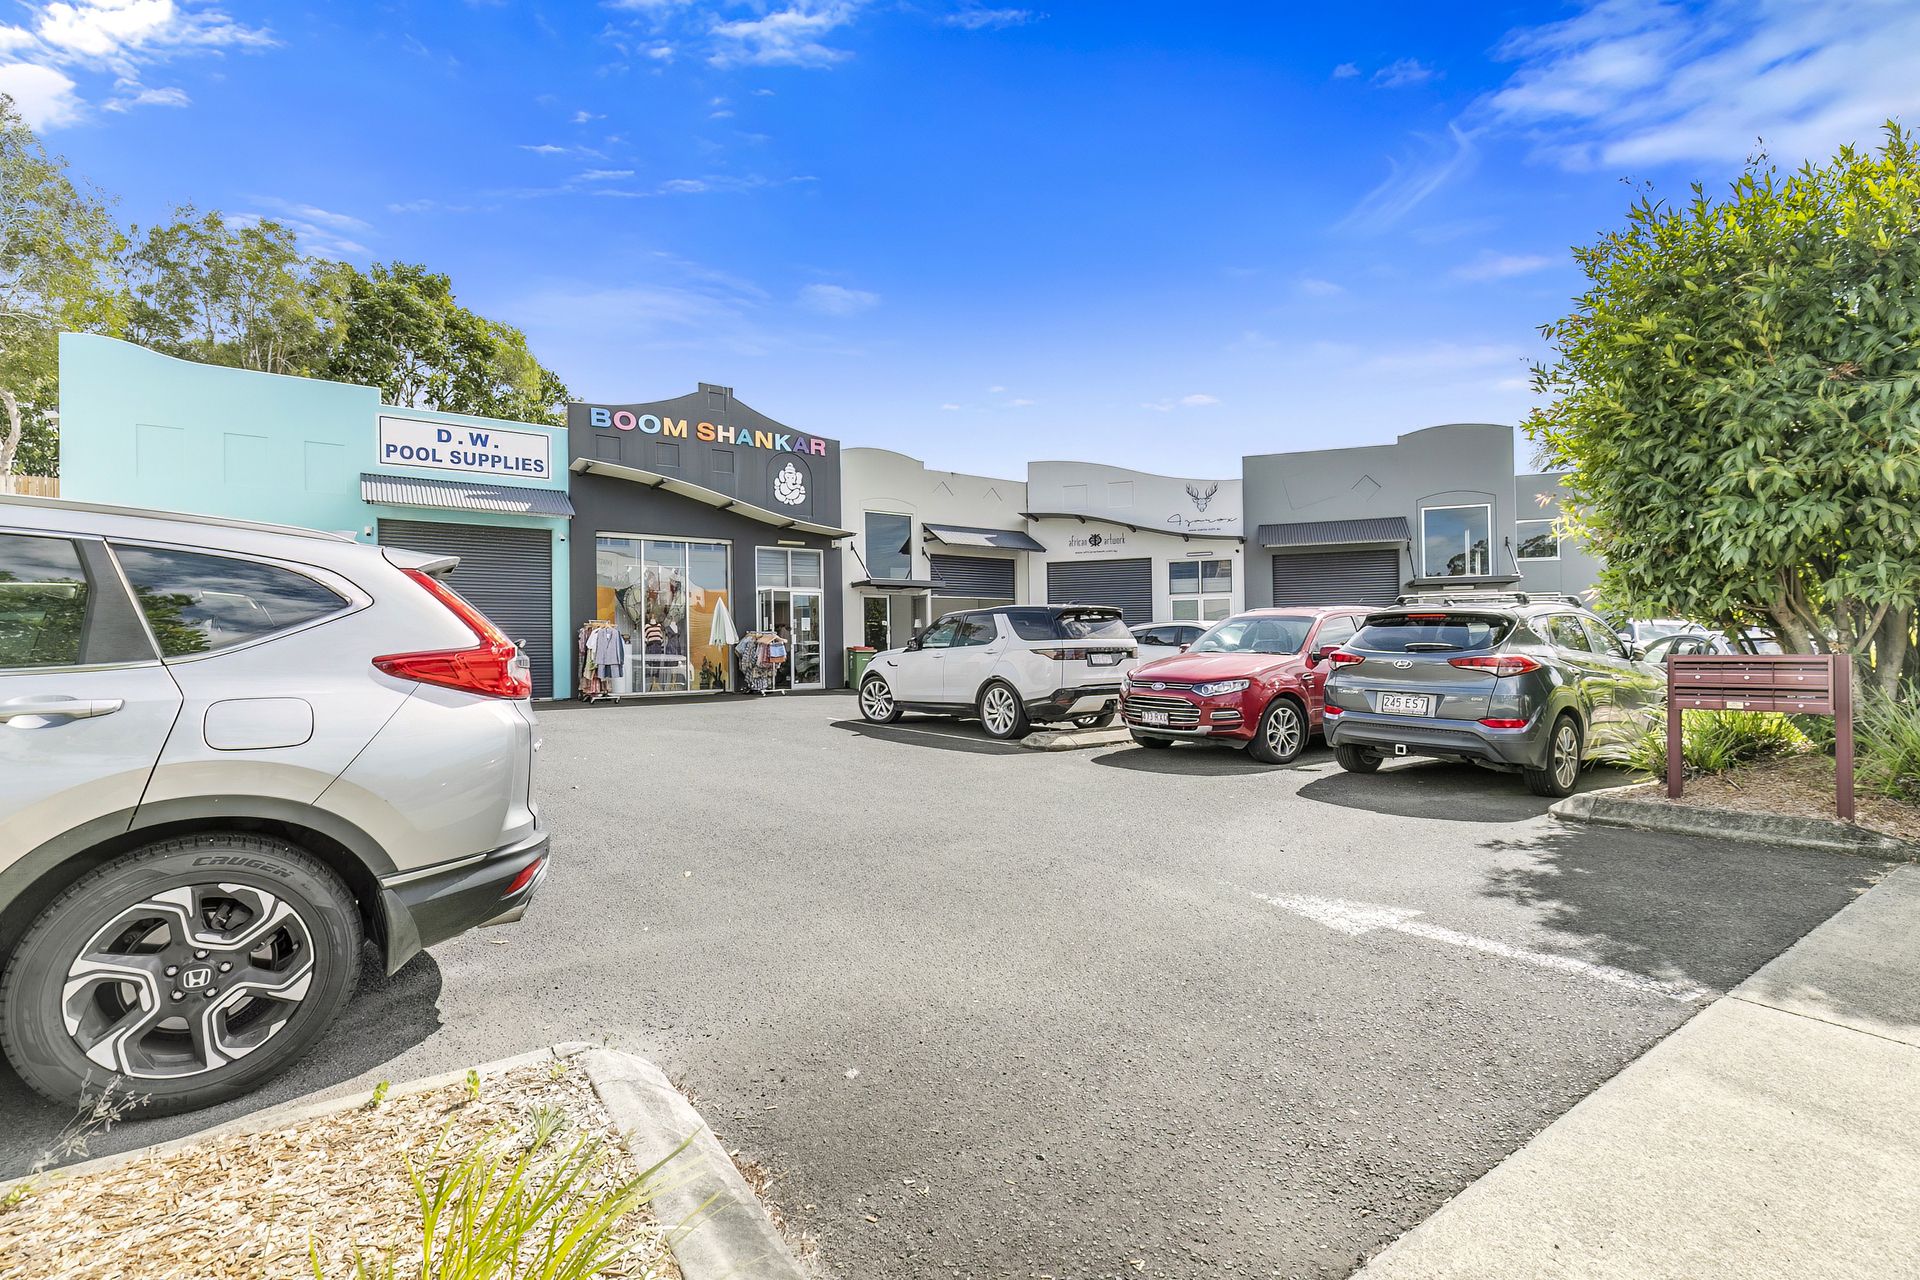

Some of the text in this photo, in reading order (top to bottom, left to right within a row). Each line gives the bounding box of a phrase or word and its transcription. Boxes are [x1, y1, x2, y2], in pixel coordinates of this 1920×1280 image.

[590, 407, 826, 456] BOOM SHANKAR
[385, 443, 544, 473] POOL SUPPLIES
[1068, 532, 1125, 547] african artwork
[1384, 696, 1426, 709] 245 ES7
[192, 856, 295, 878] CRUGEN
